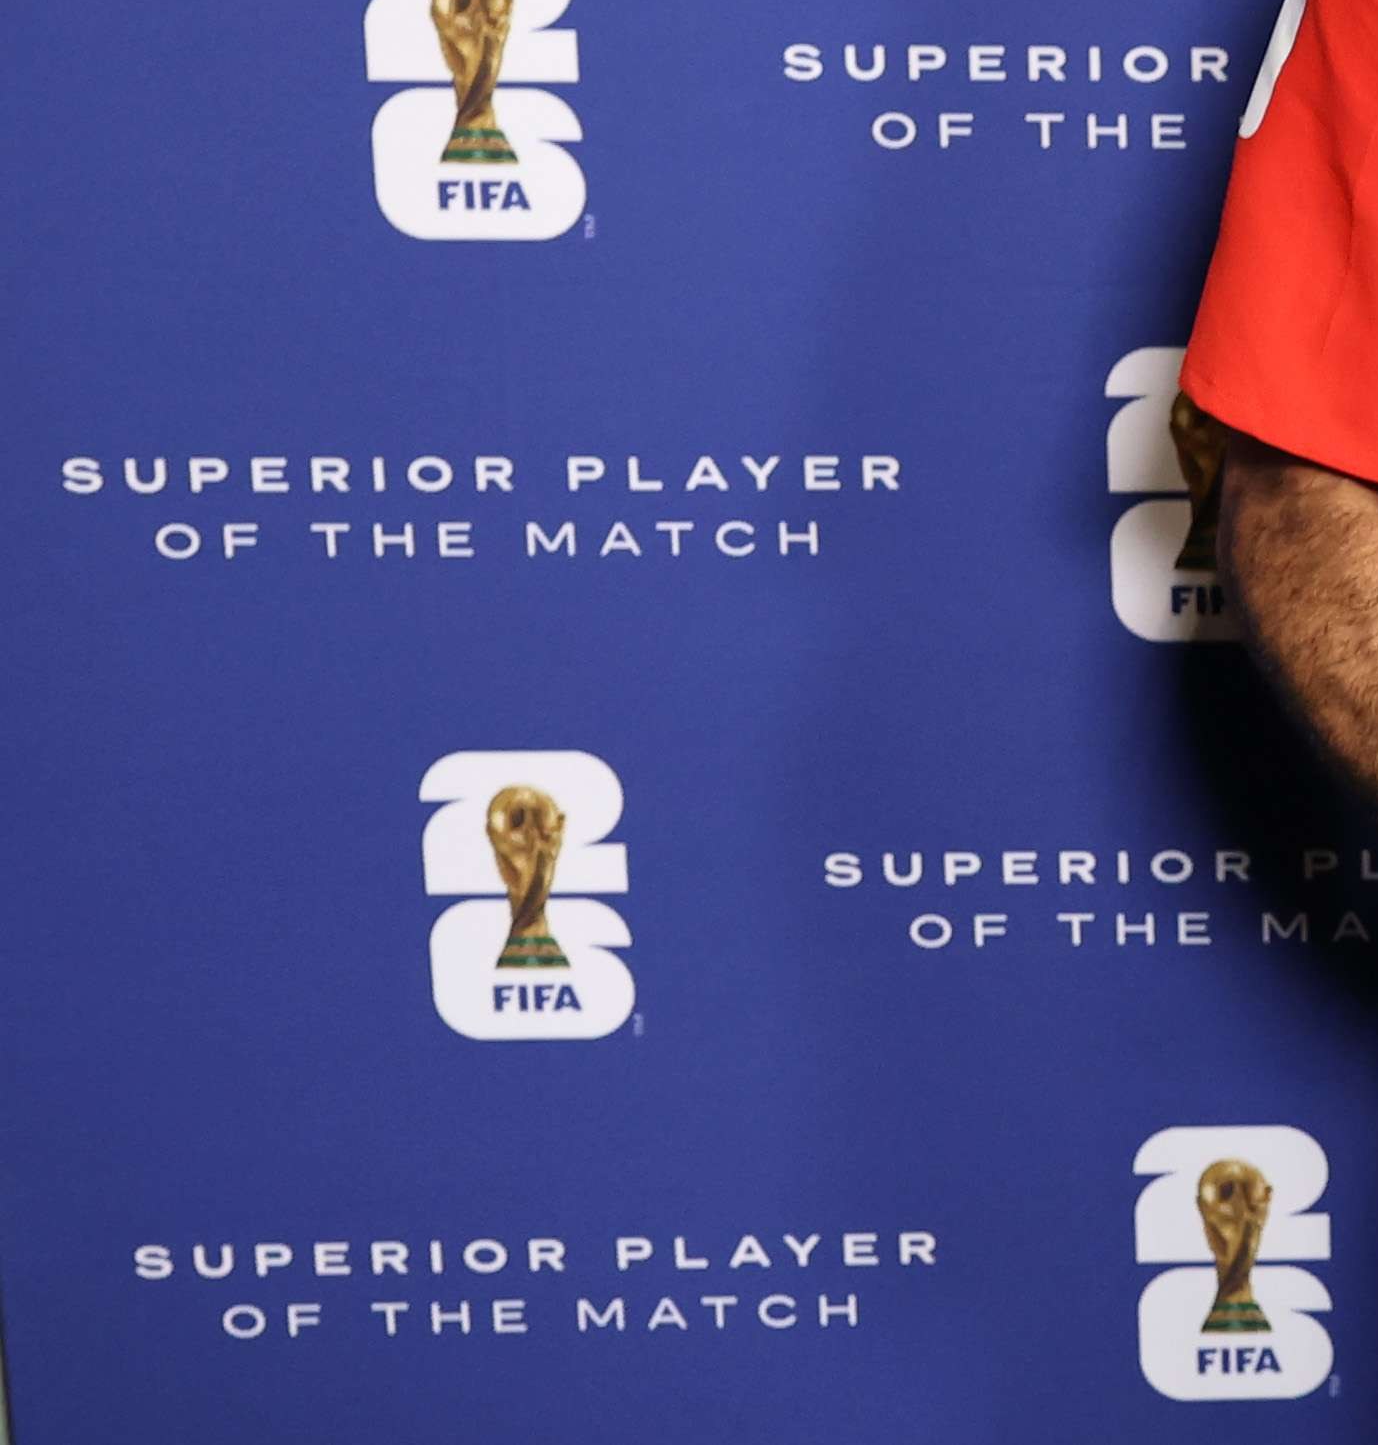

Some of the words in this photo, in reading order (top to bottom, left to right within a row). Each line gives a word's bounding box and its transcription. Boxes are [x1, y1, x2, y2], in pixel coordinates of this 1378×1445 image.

[783, 43, 1229, 84] SUPERIOR
[871, 111, 974, 150] OF
[1023, 112, 1187, 150] THE
[437, 180, 531, 210] FIFA
[61, 455, 514, 495] SUPERIOR
[566, 455, 900, 492] PLAYER
[154, 522, 259, 560] OF
[309, 521, 475, 558] THE
[525, 520, 819, 558] MATCH
[823, 849, 1249, 888] SUPERIOR
[908, 913, 1008, 949] OF
[1056, 912, 1212, 947] THE
[493, 984, 582, 1012] FIFA
[133, 1237, 566, 1280] SUPERIOR
[615, 1231, 937, 1271] PLAYER
[222, 1302, 322, 1339] OF
[370, 1299, 529, 1336] THE
[576, 1293, 858, 1332] MATCH
[1197, 1347, 1281, 1375] FIFA
